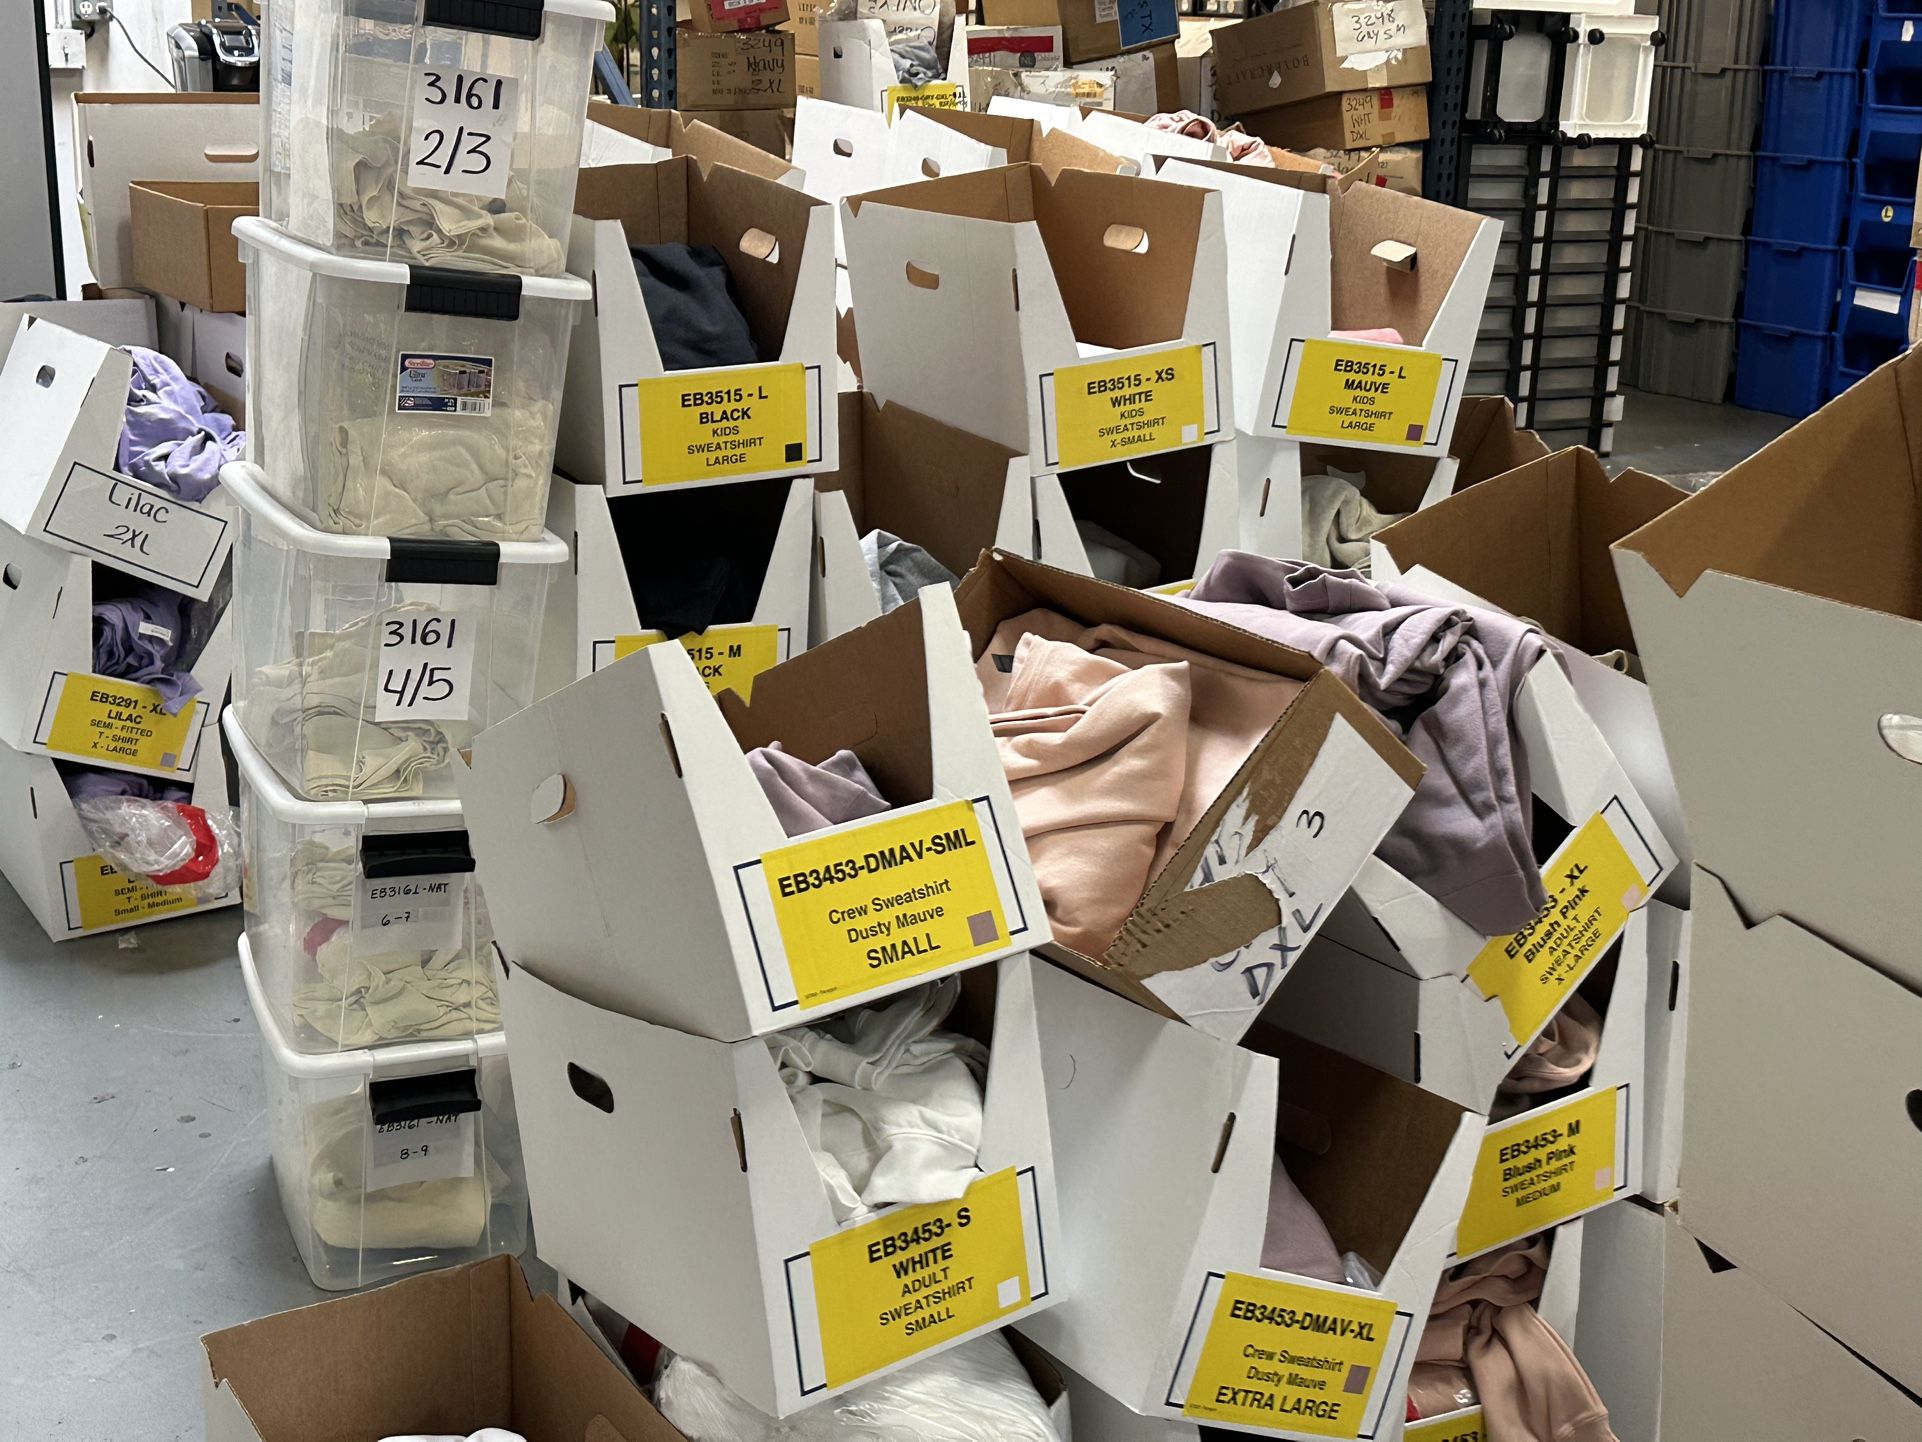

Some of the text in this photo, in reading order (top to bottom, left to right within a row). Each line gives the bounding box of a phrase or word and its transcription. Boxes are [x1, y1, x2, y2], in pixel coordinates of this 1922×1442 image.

[1352, 8, 1395, 30] 3248
[741, 38, 785, 57] 3249
[424, 72, 503, 110] 3161
[1346, 96, 1374, 112] 3249
[1350, 131, 1371, 142] DXL
[416, 126, 491, 174] 2/3
[1884, 207, 1891, 218] L
[1334, 358, 1387, 377] EB3515
[1397, 366, 1407, 379] L
[1086, 374, 1142, 396] EB3515
[1154, 368, 1175, 384] XS
[1344, 378, 1390, 394] MAUVE
[681, 388, 742, 408] EB3515
[758, 386, 768, 400] L
[1110, 390, 1154, 408] WHITE
[1352, 394, 1376, 406] KIDS
[700, 407, 752, 424] BLACK
[1120, 408, 1144, 420] KIDS
[1328, 405, 1394, 420] SWEATSHIRT
[712, 426, 740, 438] KIDS
[1098, 416, 1166, 438] SWEATSHIRT
[1340, 420, 1376, 432] LARGE
[688, 436, 764, 454] SWEATSHIRT
[1110, 432, 1156, 448] X-SMALL
[706, 453, 746, 466] LARGE
[108, 482, 170, 524] Lilac
[103, 524, 151, 556] 2XL
[384, 618, 456, 648] 3161
[688, 646, 714, 661] 515
[728, 644, 742, 658] M
[384, 662, 454, 707] 4/5
[90, 690, 138, 710] EB3291
[90, 718, 112, 732] SEMI
[120, 724, 153, 738] FITTED
[107, 709, 143, 724] LILAC
[92, 741, 99, 750] X
[106, 744, 138, 757] LARGE
[112, 734, 140, 746] SHIRT
[1296, 809, 1326, 839] 3
[778, 828, 976, 898] EB3453-DMAV-SML
[1564, 863, 1588, 886] XL
[114, 904, 140, 916] Small
[148, 897, 182, 909] Medium
[126, 896, 132, 904] T
[828, 878, 952, 924] Crew Sweatshirt
[847, 906, 945, 943] Dusty Mauve
[1523, 885, 1590, 964] Blush Pink
[1549, 914, 1582, 956] ADULT
[866, 932, 941, 969] SMALL
[1241, 903, 1323, 1006] DXL
[1540, 906, 1602, 984] SWEATSHIRT
[1499, 1120, 1580, 1164] EB3453- M
[1502, 1144, 1576, 1182] Blush Pink
[1502, 1161, 1575, 1198] SWEATSHIRT
[1516, 1182, 1560, 1208] MEDIUM
[868, 1207, 971, 1264] EB3453- S
[892, 1242, 954, 1279] WHITE
[901, 1266, 950, 1298] ADULT
[879, 1276, 974, 1326] SWEATSHIRT
[904, 1306, 955, 1336] SMALL
[1229, 1299, 1376, 1342] EB3453-DMAV-XL
[1242, 1344, 1344, 1373] Crew Sweatshirt
[1246, 1366, 1327, 1390] Dusty Mauve
[1216, 1386, 1341, 1420] EXTRA LARGE
